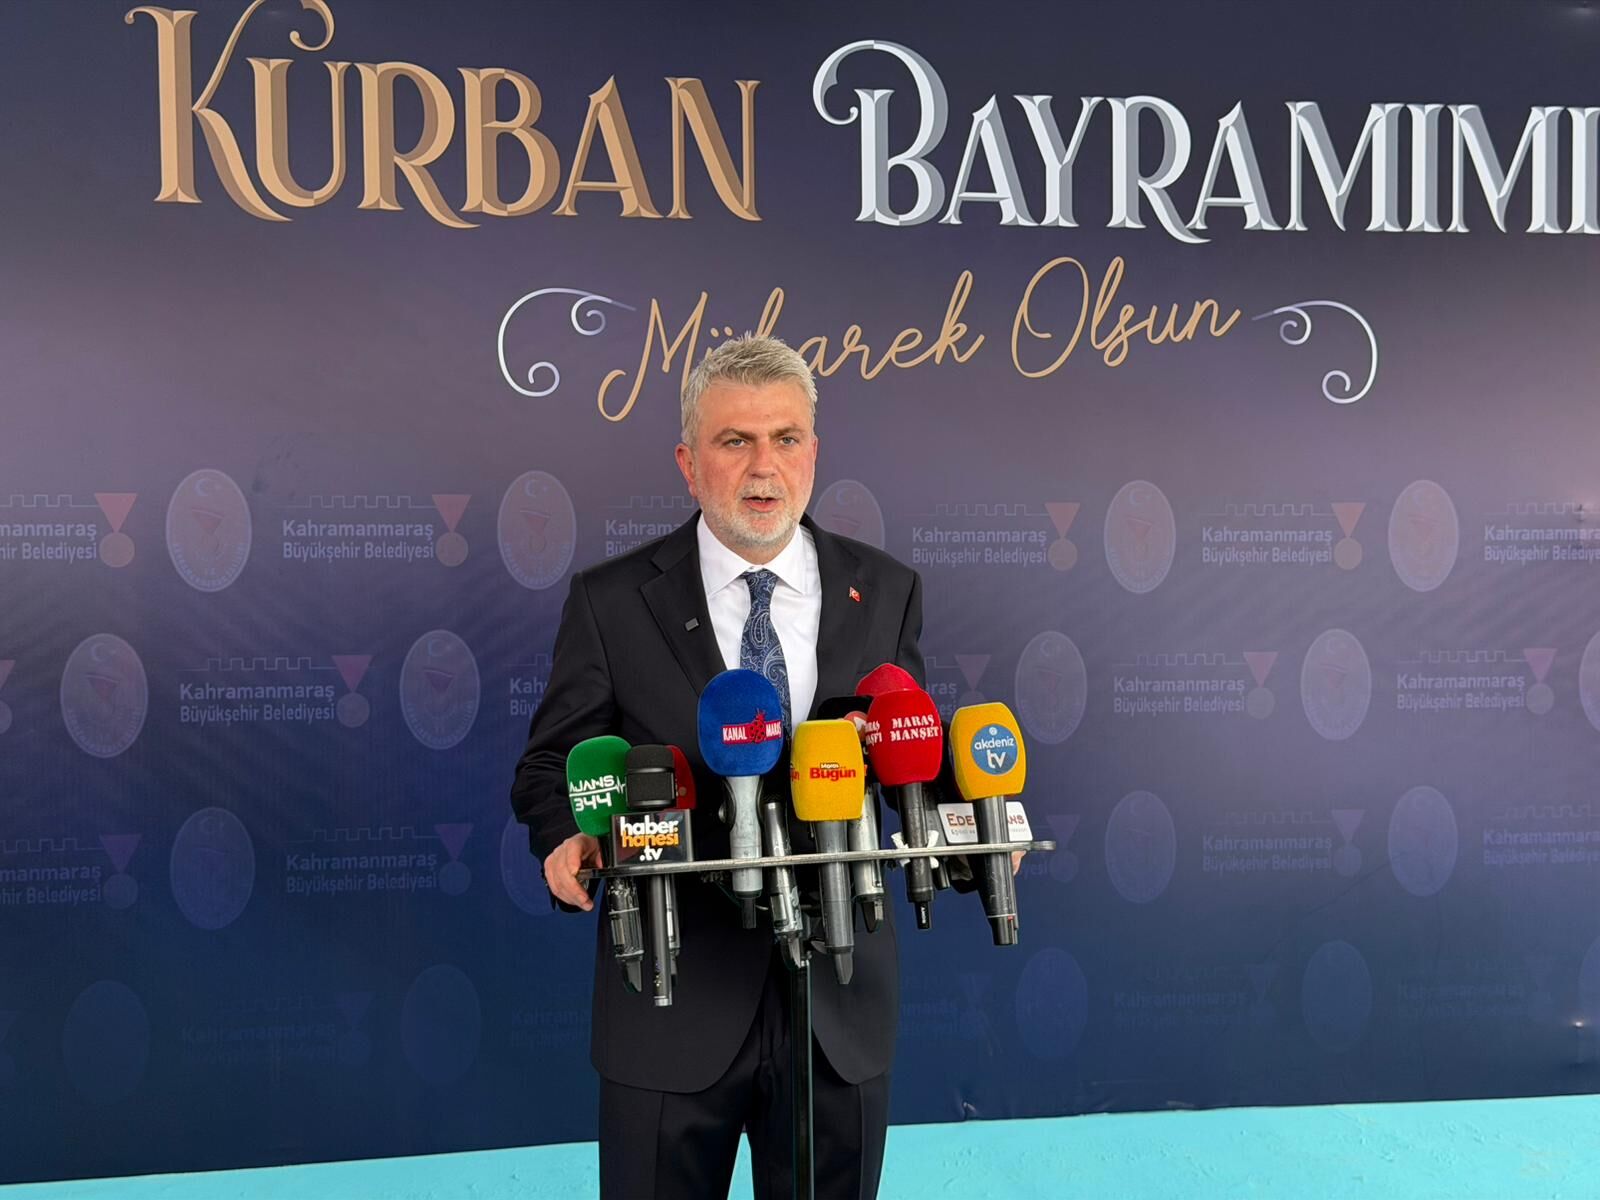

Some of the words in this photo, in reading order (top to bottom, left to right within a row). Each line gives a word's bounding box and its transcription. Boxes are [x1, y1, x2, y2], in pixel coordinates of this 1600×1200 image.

[125, 0, 763, 229] KURBAN
[1009, 256, 1241, 379] Olsun
[282, 519, 435, 541] Kahramanmaraş
[911, 525, 1047, 546] Kahramanmaraş
[1201, 525, 1333, 546] Kahramanmaraş
[21, 541, 97, 565] Belediyesi
[282, 541, 361, 564] Büyükşehir
[364, 540, 435, 563] Belediyesi
[911, 547, 981, 568] Büyükşehir
[984, 546, 1047, 567] Belediyesi
[1201, 546, 1268, 567] Büyükşehir
[1271, 545, 1333, 567] Belediyesi
[1483, 545, 1549, 566] Büyükşehir
[179, 682, 336, 702] Kahramanmaraş
[1113, 675, 1247, 696] Kahramanmaraş
[1396, 672, 1526, 692] Kahramanmaraş
[180, 704, 261, 727] Büyükşehir
[263, 703, 336, 725] Belediyesi
[1113, 696, 1181, 718] Büyükşehir
[1183, 695, 1247, 716] Belediyesi
[891, 714, 934, 729] MARAŞ
[723, 726, 747, 741] KANAL
[890, 726, 939, 742] MANŞET
[974, 736, 1014, 750] akdeniz
[987, 750, 1007, 769] tv
[569, 774, 615, 793] AJANS
[809, 766, 856, 782] Bugün
[573, 792, 612, 812] 344
[621, 827, 679, 848] hanesi
[286, 851, 438, 872] Kahramanmaraş
[639, 845, 664, 862] .tv
[286, 872, 364, 896] Büyükşehir
[367, 870, 438, 893] Belediyesi
[26, 884, 102, 906] Belediyesi
